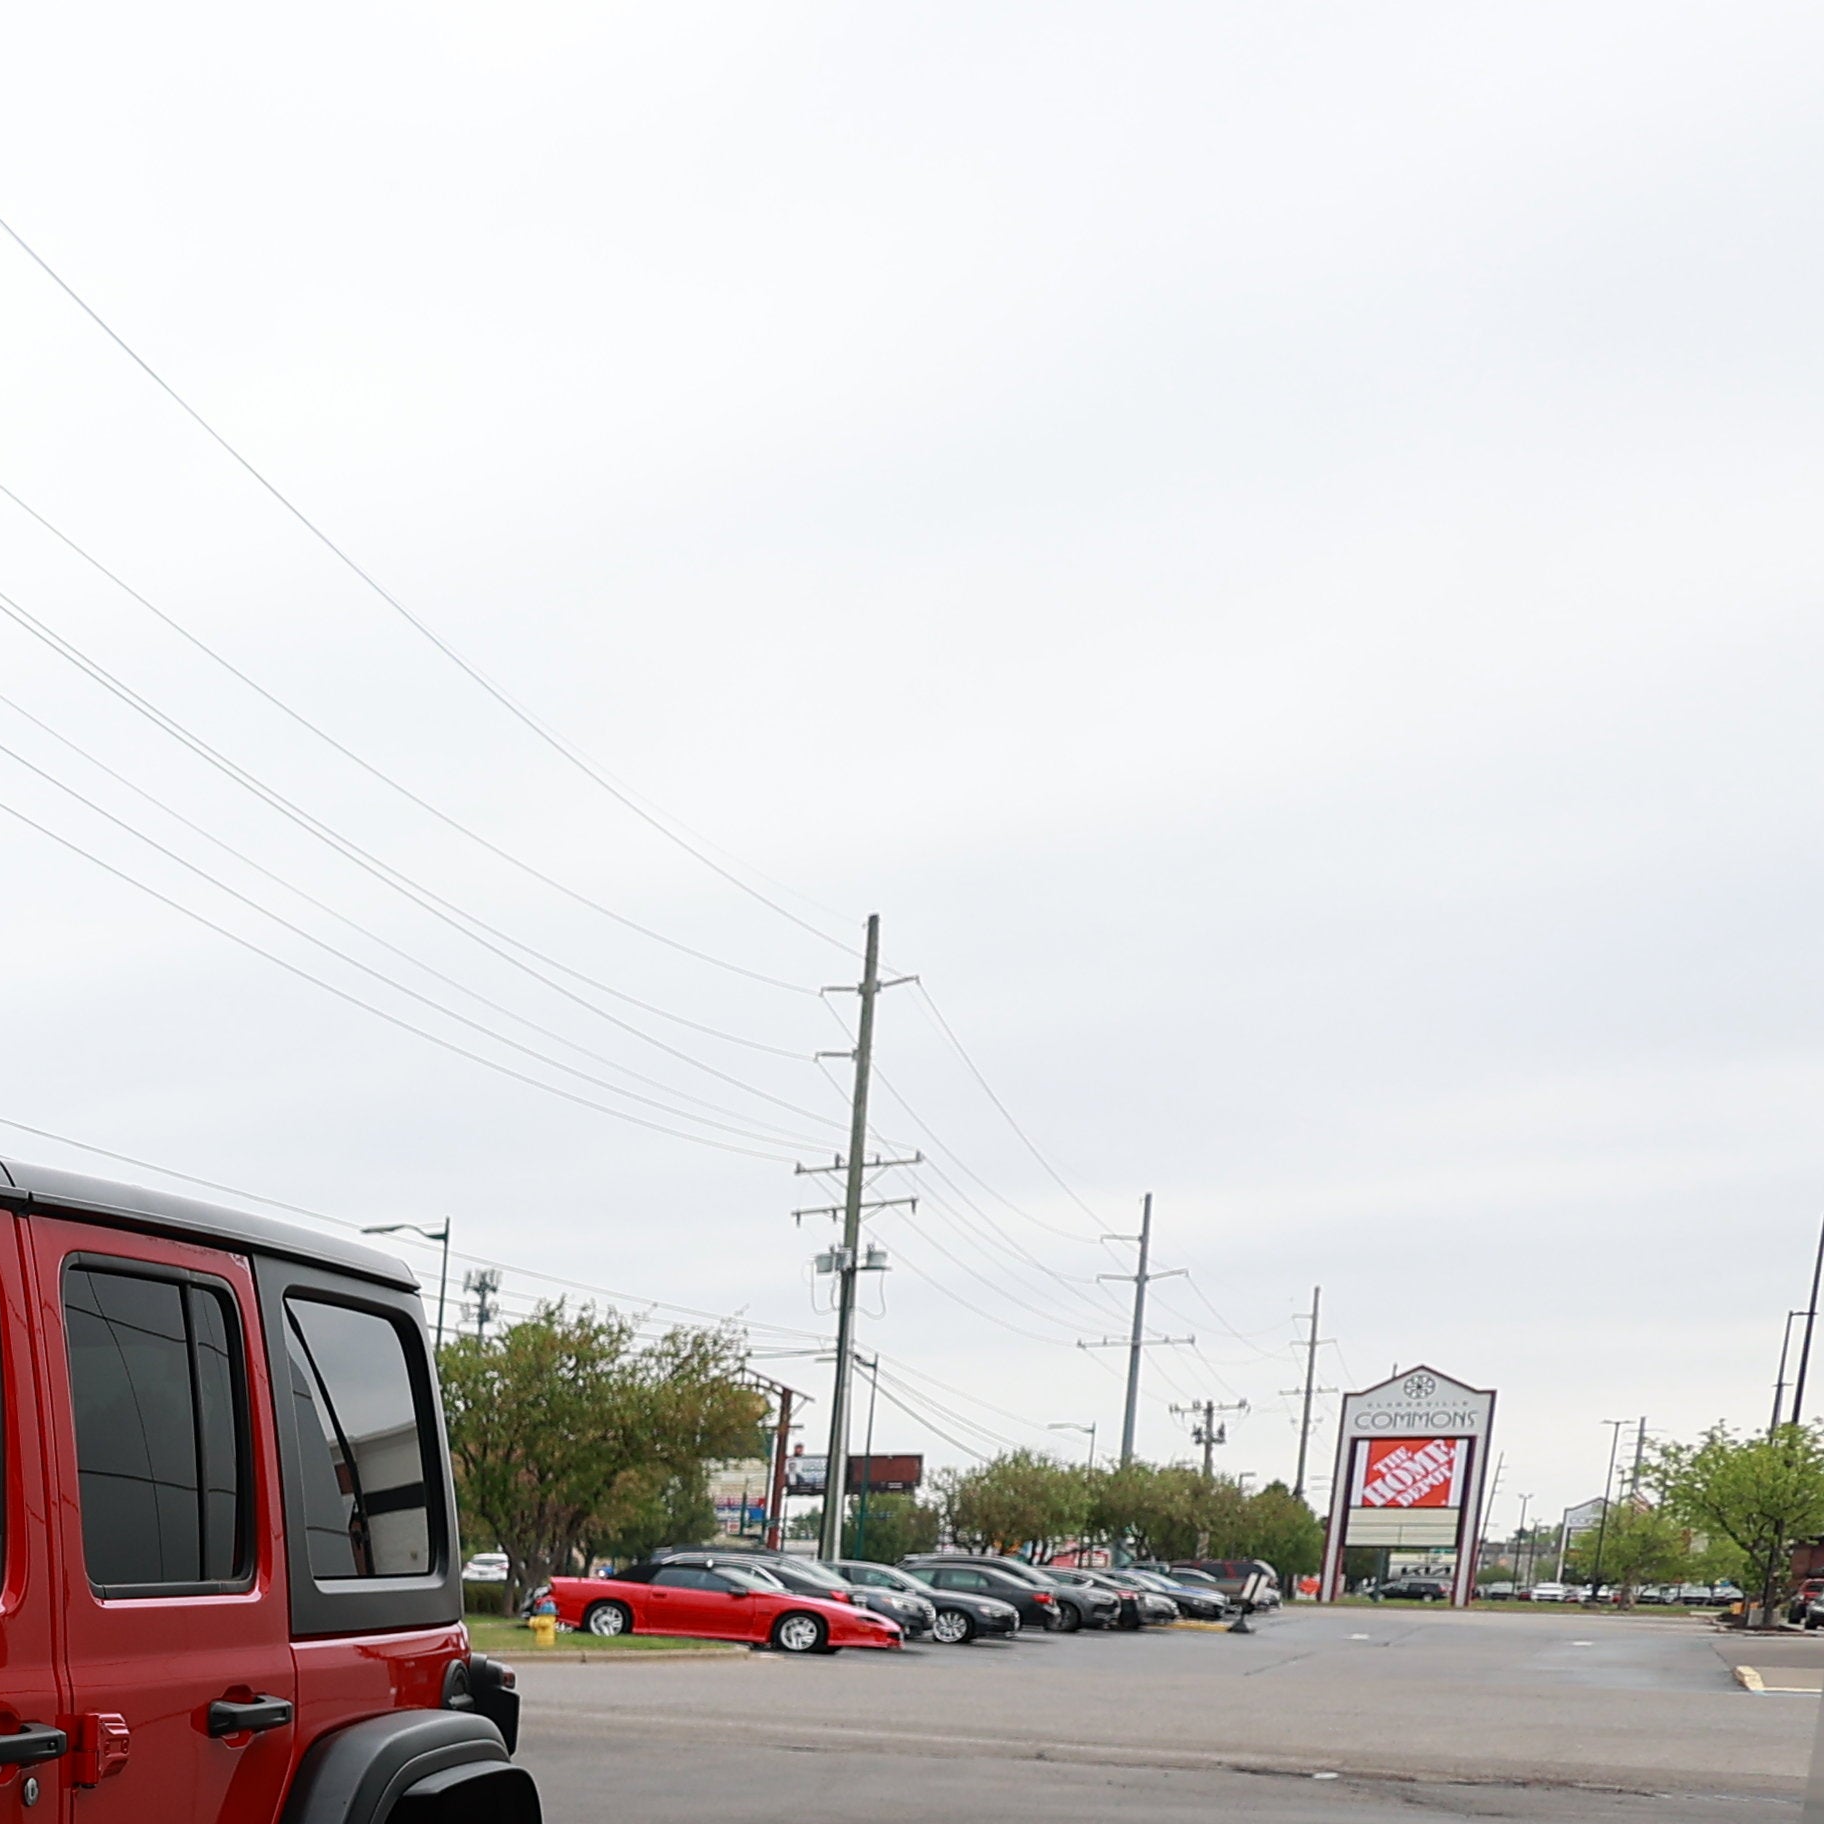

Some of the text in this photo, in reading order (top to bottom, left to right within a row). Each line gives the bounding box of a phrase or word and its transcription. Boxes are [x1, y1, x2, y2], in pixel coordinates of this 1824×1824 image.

[1354, 1409, 1479, 1430] COMMONS
[1362, 1438, 1456, 1507] HOME
[1372, 1445, 1413, 1473] THE
[1395, 1464, 1453, 1507] DEPOT
